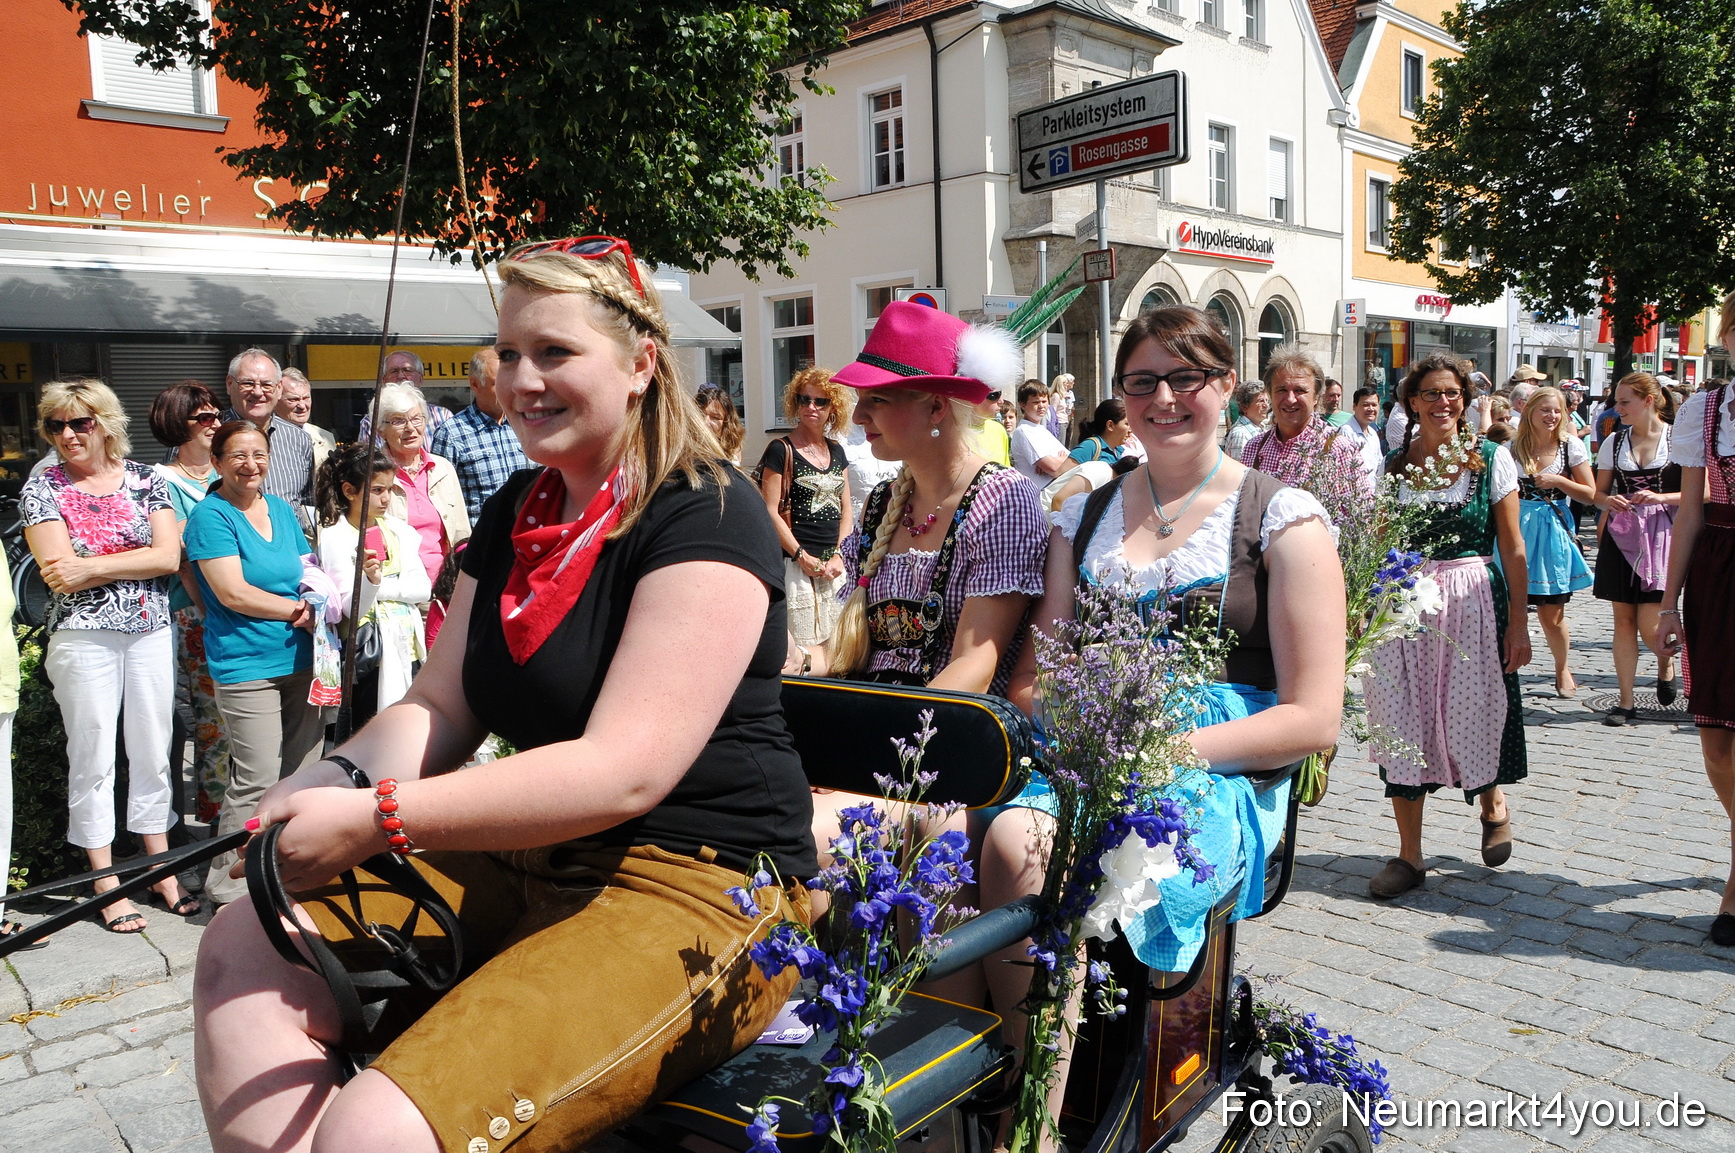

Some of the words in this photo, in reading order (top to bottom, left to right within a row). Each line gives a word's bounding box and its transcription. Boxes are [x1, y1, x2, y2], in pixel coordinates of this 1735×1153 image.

[1042, 96, 1146, 136] Parkleitsystem
[1055, 157, 1064, 173] P
[1079, 136, 1148, 164] Rosengasse
[1193, 225, 1275, 254] HypoVereinsbank
[1417, 294, 1453, 317] orsay
